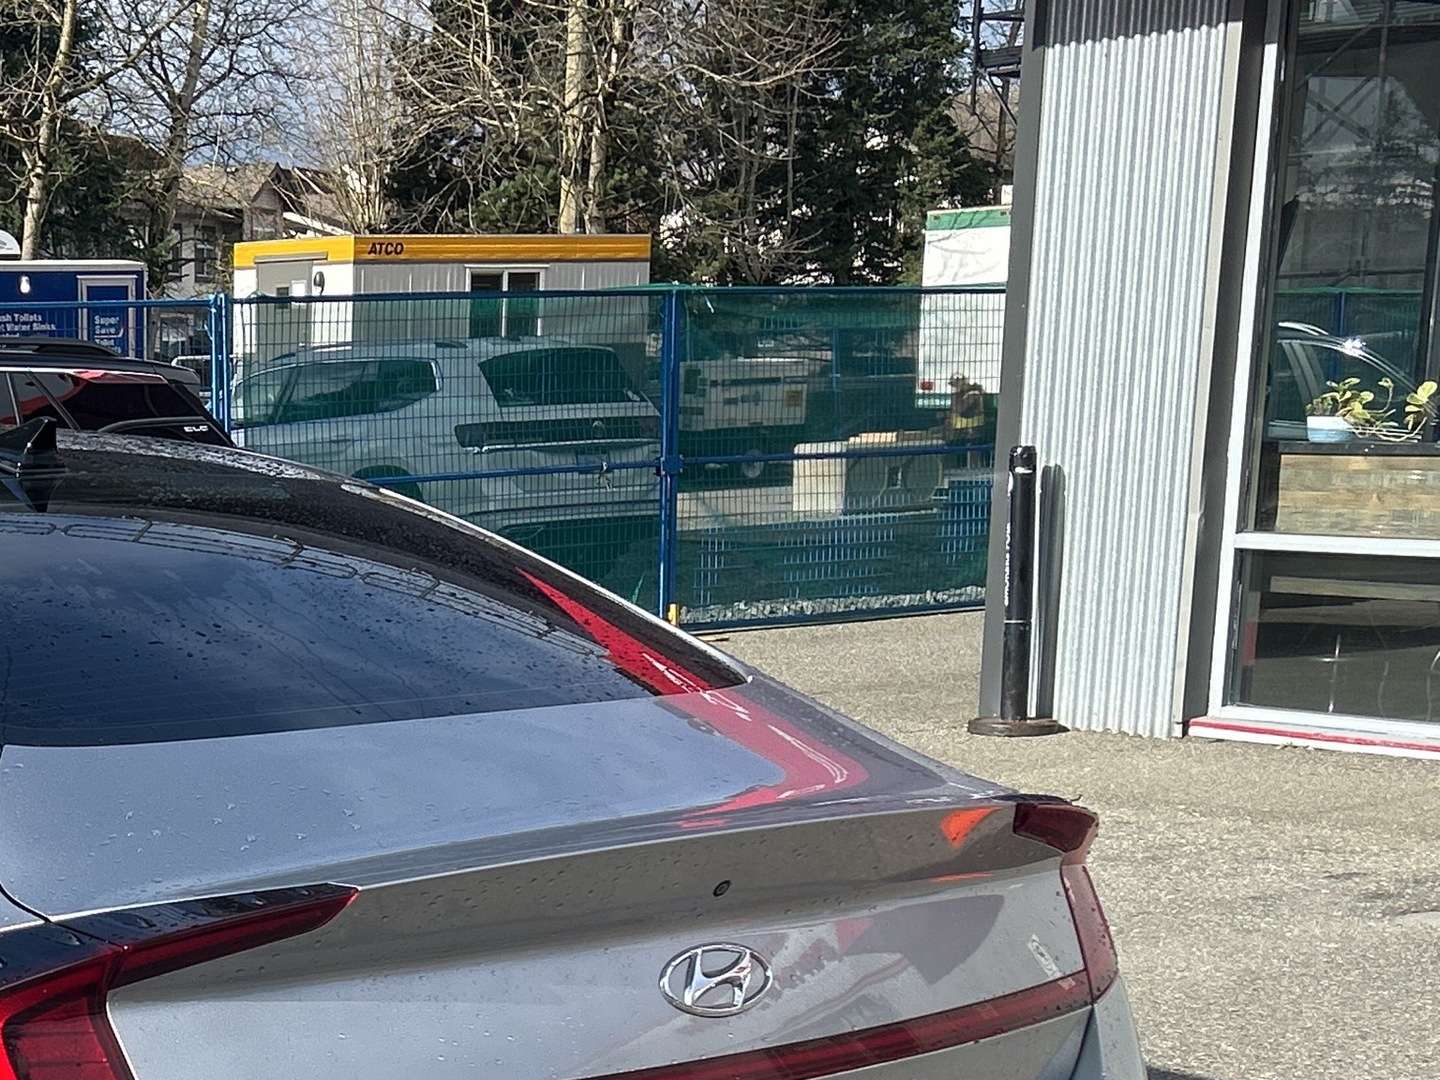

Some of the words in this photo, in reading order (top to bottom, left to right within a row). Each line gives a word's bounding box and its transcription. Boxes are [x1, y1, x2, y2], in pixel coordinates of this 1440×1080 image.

[368, 242, 404, 256] ATCO
[13, 313, 42, 322] Toilets
[94, 315, 120, 326] Super
[6, 323, 31, 331] Water
[32, 322, 57, 331] Sinks
[94, 325, 116, 334] Save
